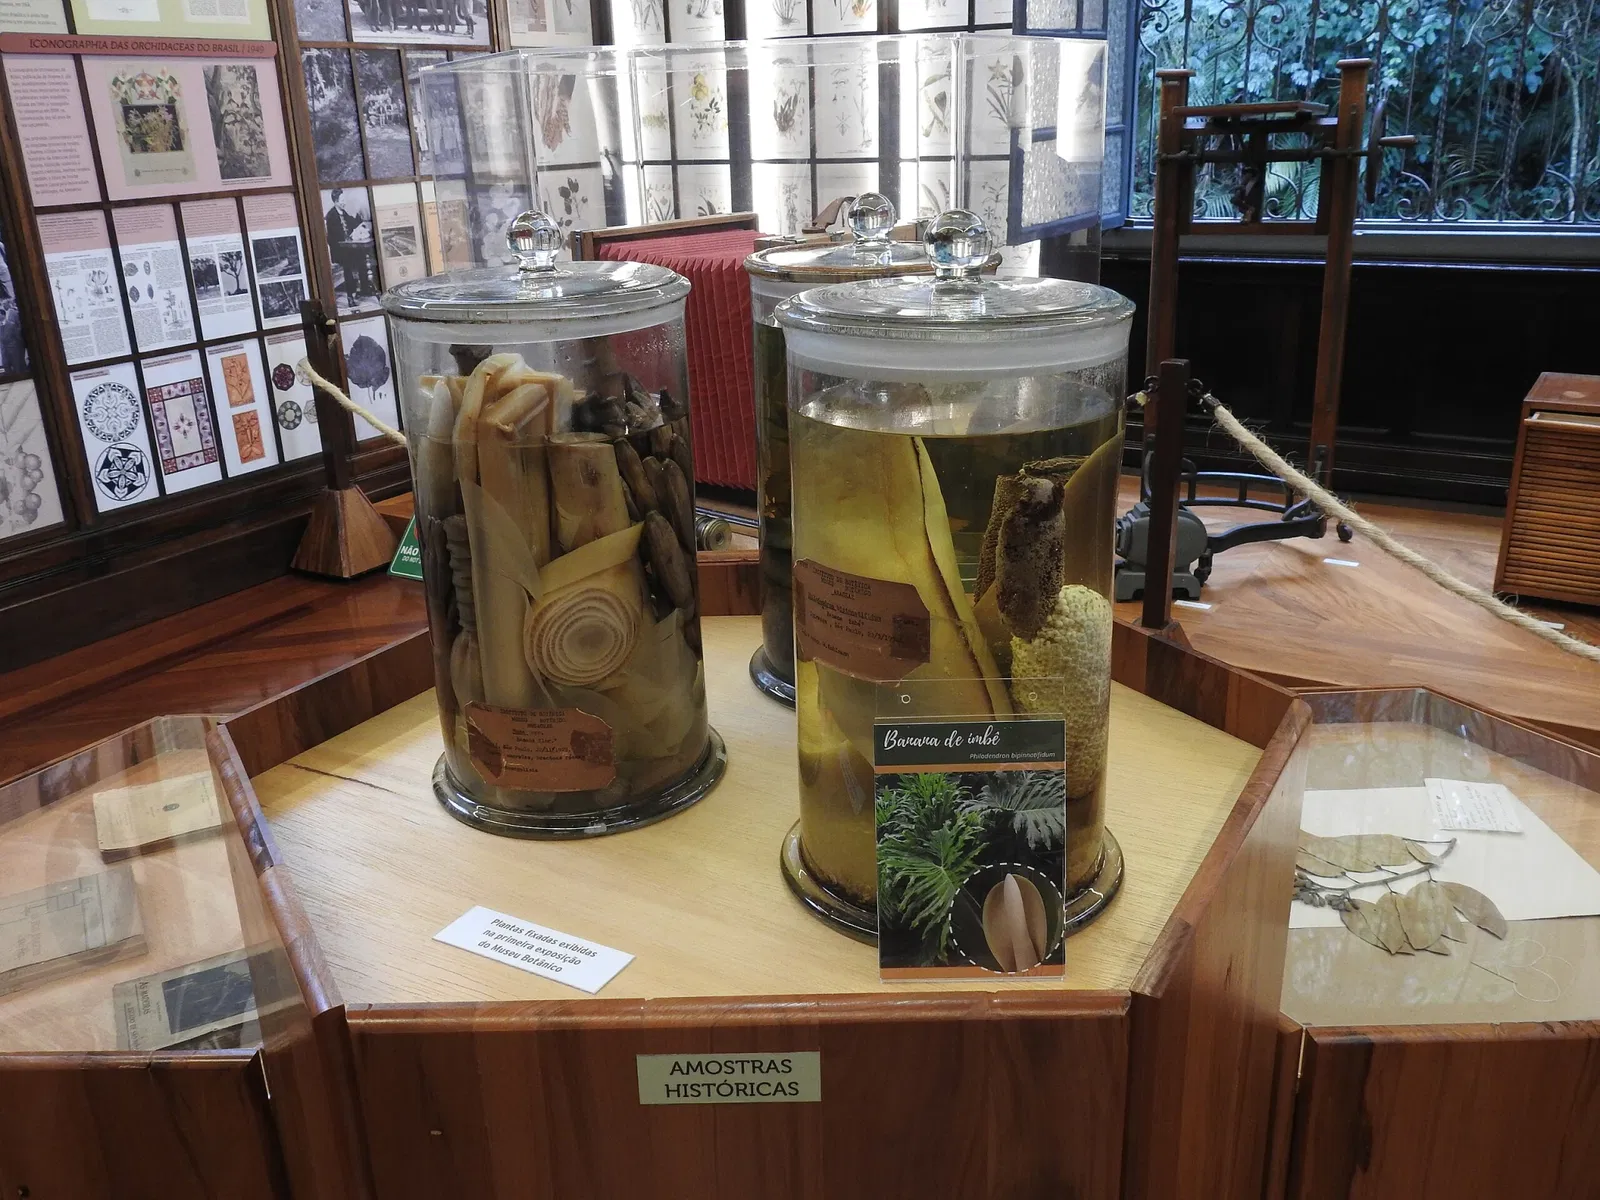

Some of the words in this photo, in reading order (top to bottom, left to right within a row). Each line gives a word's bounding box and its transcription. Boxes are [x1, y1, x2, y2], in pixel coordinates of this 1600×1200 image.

[30, 39, 108, 50] ICONOGRAPHIA
[110, 41, 129, 50] DAS
[131, 41, 195, 52] ORCHIDACEAS
[197, 43, 210, 52] DO
[212, 43, 240, 53] BRASIL
[247, 45, 265, 54] 1949
[400, 545, 419, 556] NÃO
[883, 729, 941, 750] Banana
[943, 730, 964, 748] de
[967, 724, 1001, 746] imbê
[969, 752, 1010, 760] Philodendron
[1011, 751, 1056, 760] bipinnatifidum
[482, 928, 496, 938] na
[495, 932, 534, 951] primeira
[534, 945, 582, 967] exposição
[490, 918, 525, 935] Plantas
[524, 929, 559, 945] fixadas
[558, 941, 598, 958] exibidas
[477, 939, 491, 949] do
[490, 944, 521, 960] Museu
[520, 953, 563, 974] Botânico
[669, 1058, 792, 1076] AMOSTRAS
[664, 1079, 800, 1098] HISTÓRICAS
